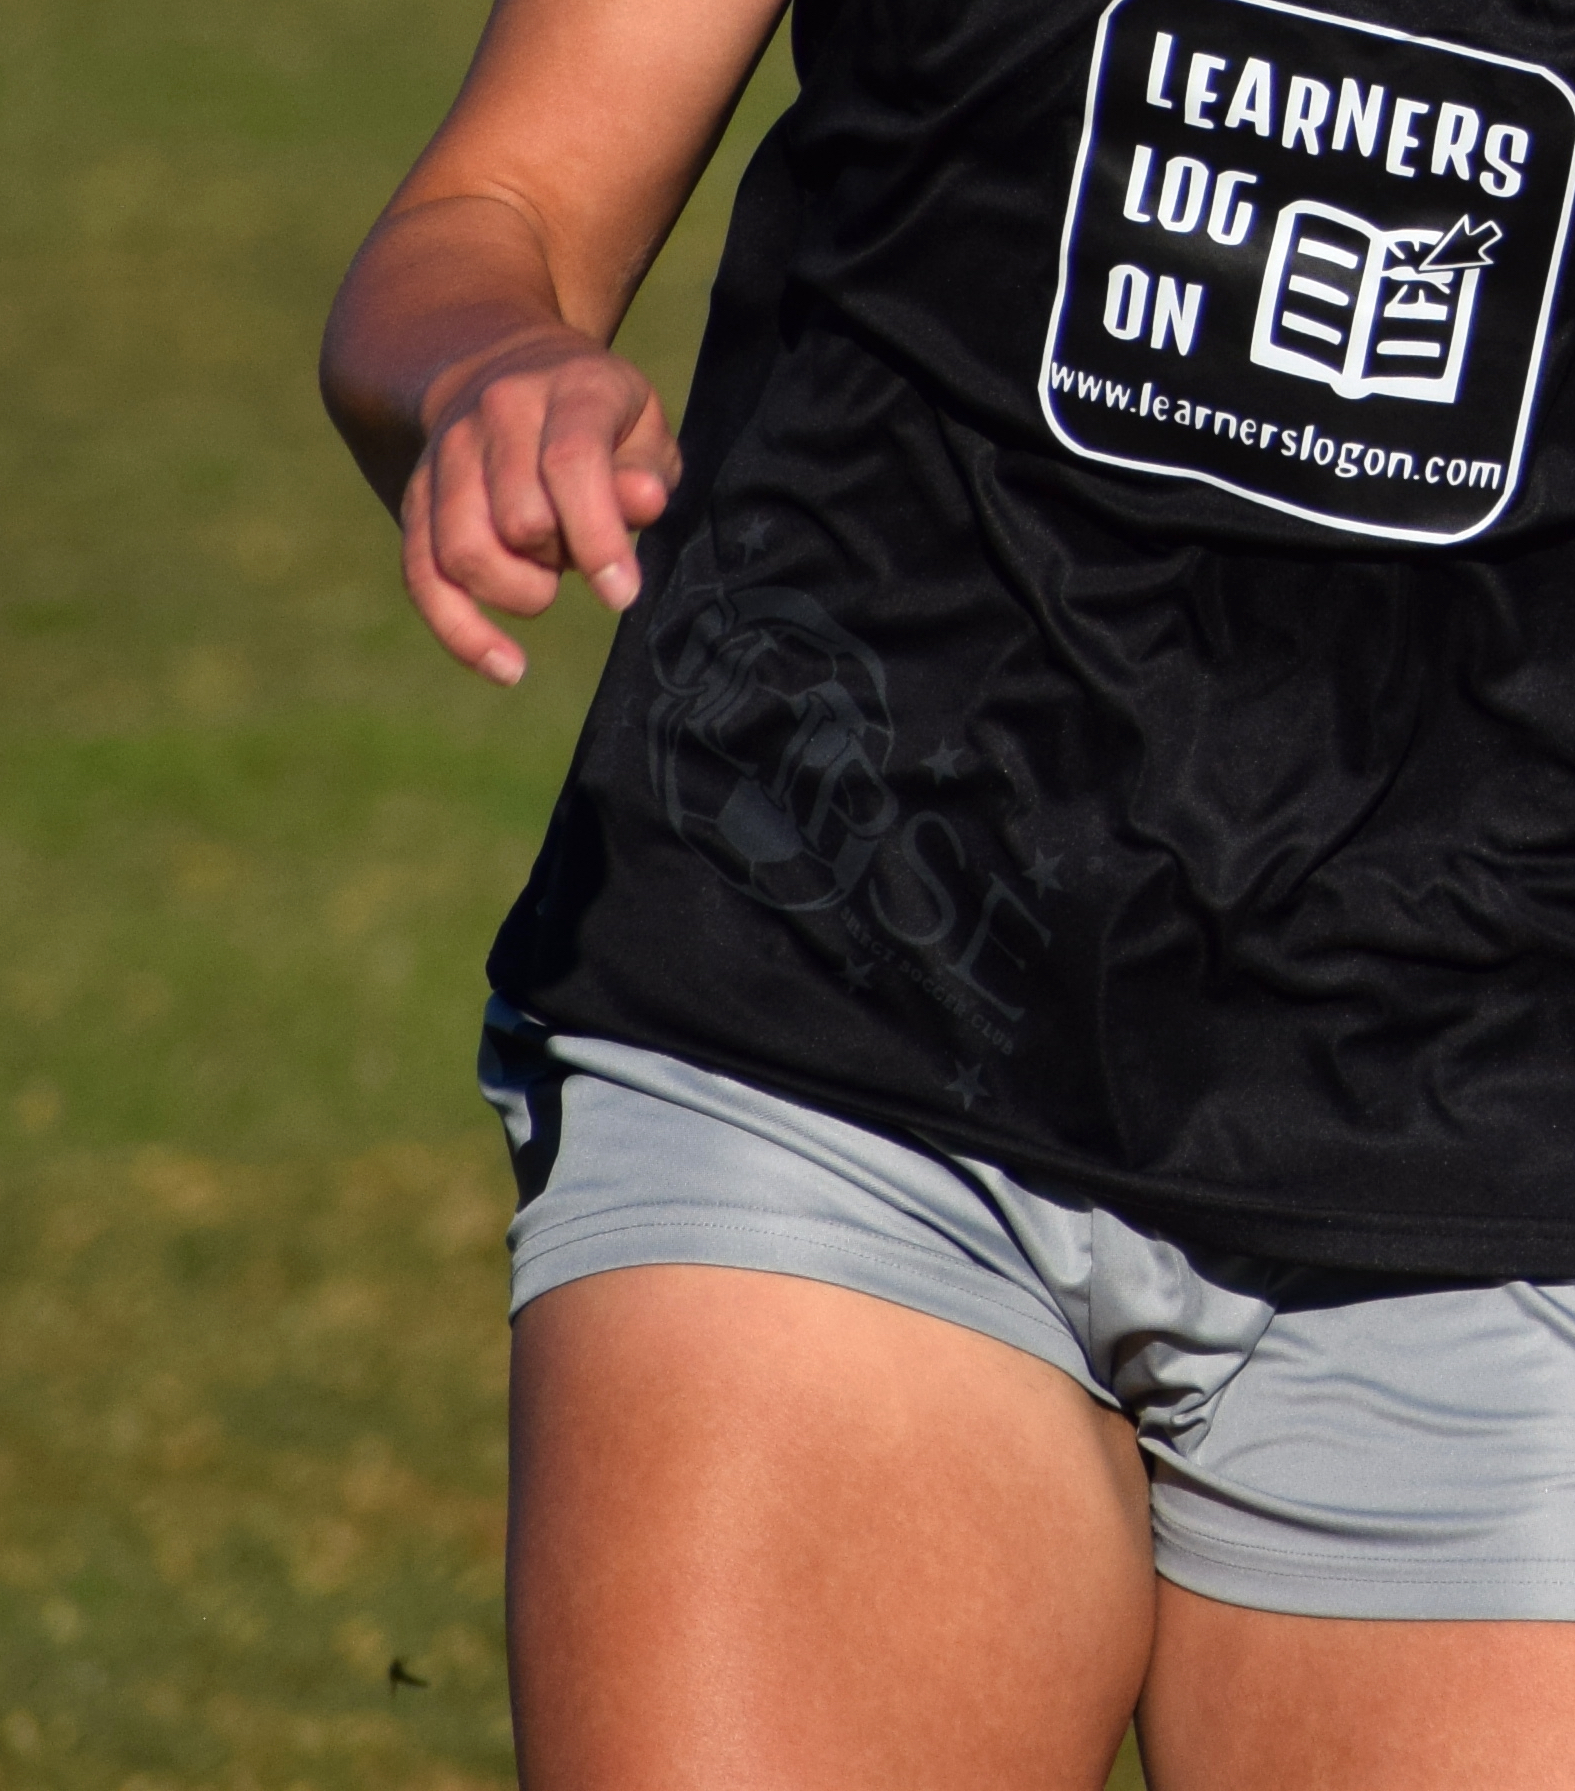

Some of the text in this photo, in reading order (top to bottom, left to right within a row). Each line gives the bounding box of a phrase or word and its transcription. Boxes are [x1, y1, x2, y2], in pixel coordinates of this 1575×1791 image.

[1145, 31, 1530, 198] LEARNERS
[1122, 144, 1258, 246] LOG
[1102, 264, 1203, 357] ON
[1049, 361, 1503, 490] www.learnerslogon.com
